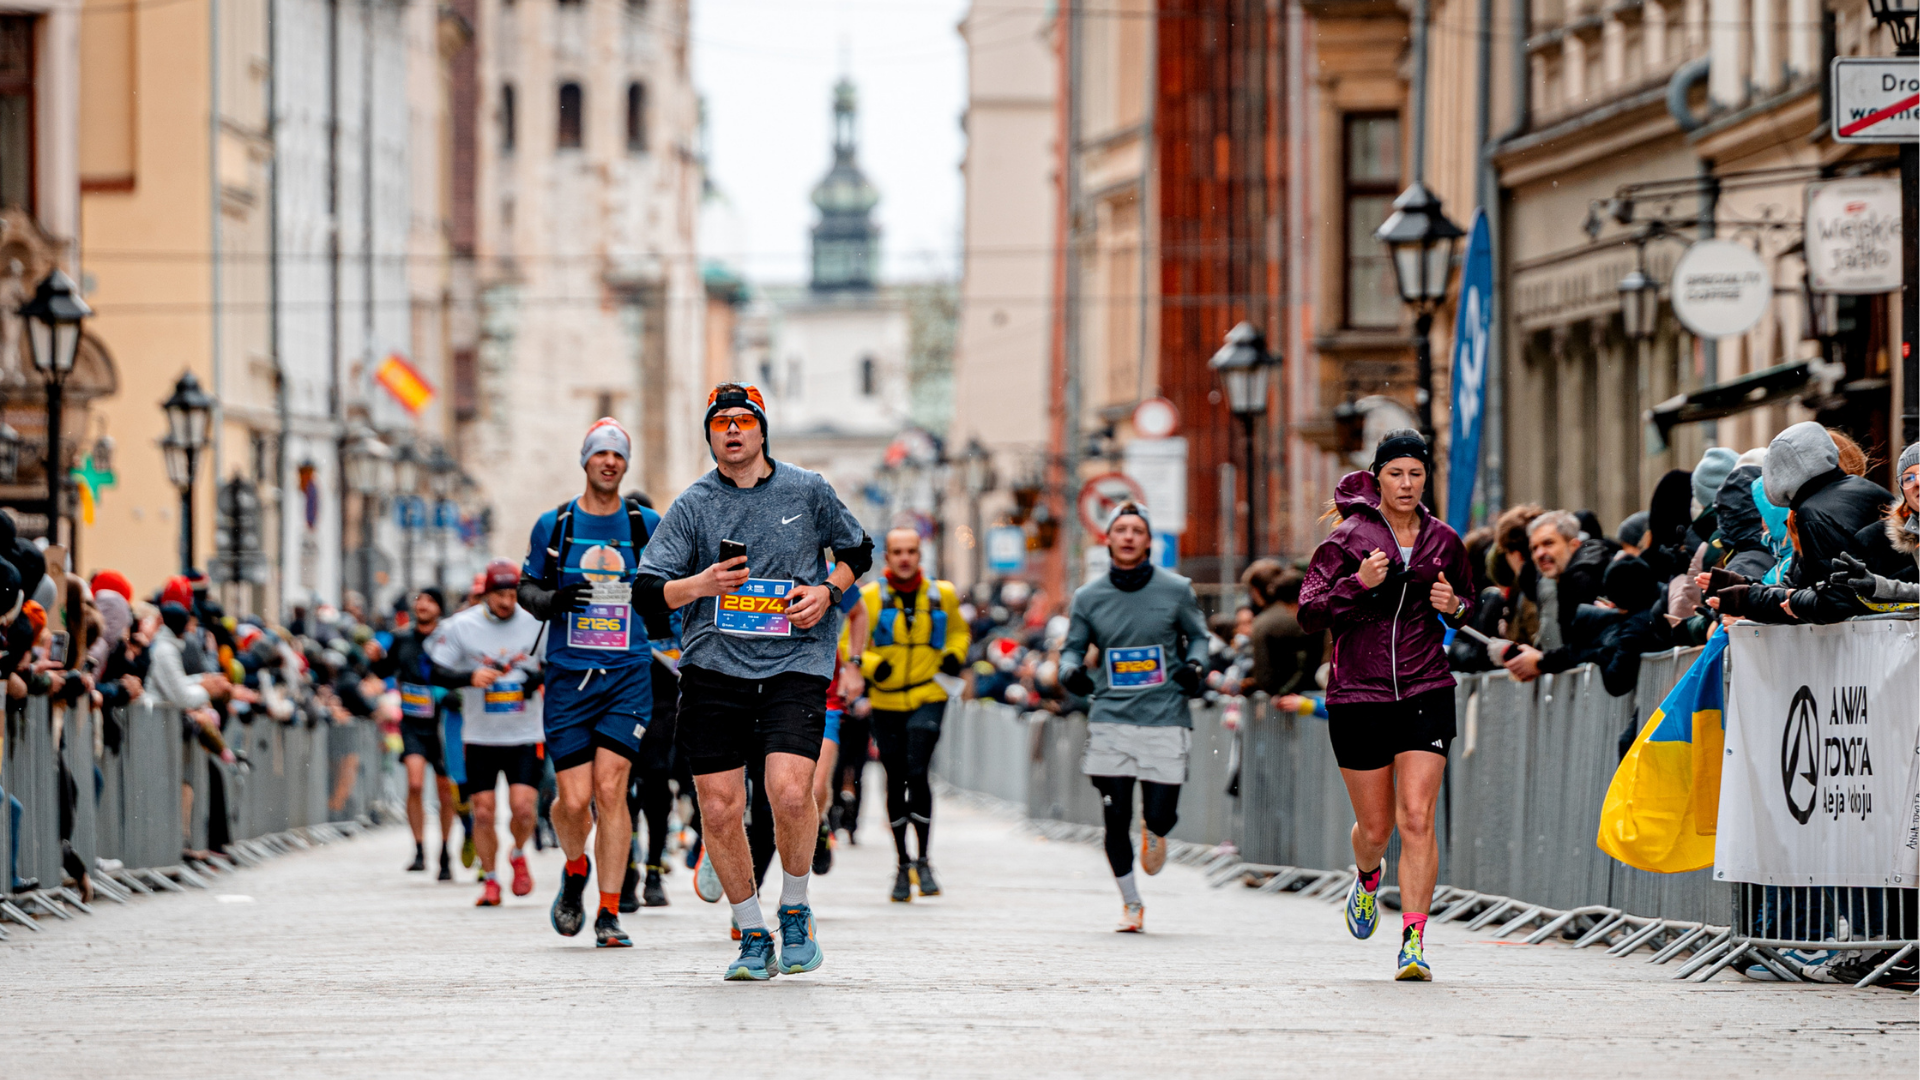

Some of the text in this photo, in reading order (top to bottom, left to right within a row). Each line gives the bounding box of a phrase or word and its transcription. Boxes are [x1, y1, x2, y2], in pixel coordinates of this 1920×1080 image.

[723, 595, 784, 612] 2874
[577, 617, 621, 630] 2126
[1114, 659, 1157, 673] 3120
[1824, 736, 1873, 776] TOYOTA
